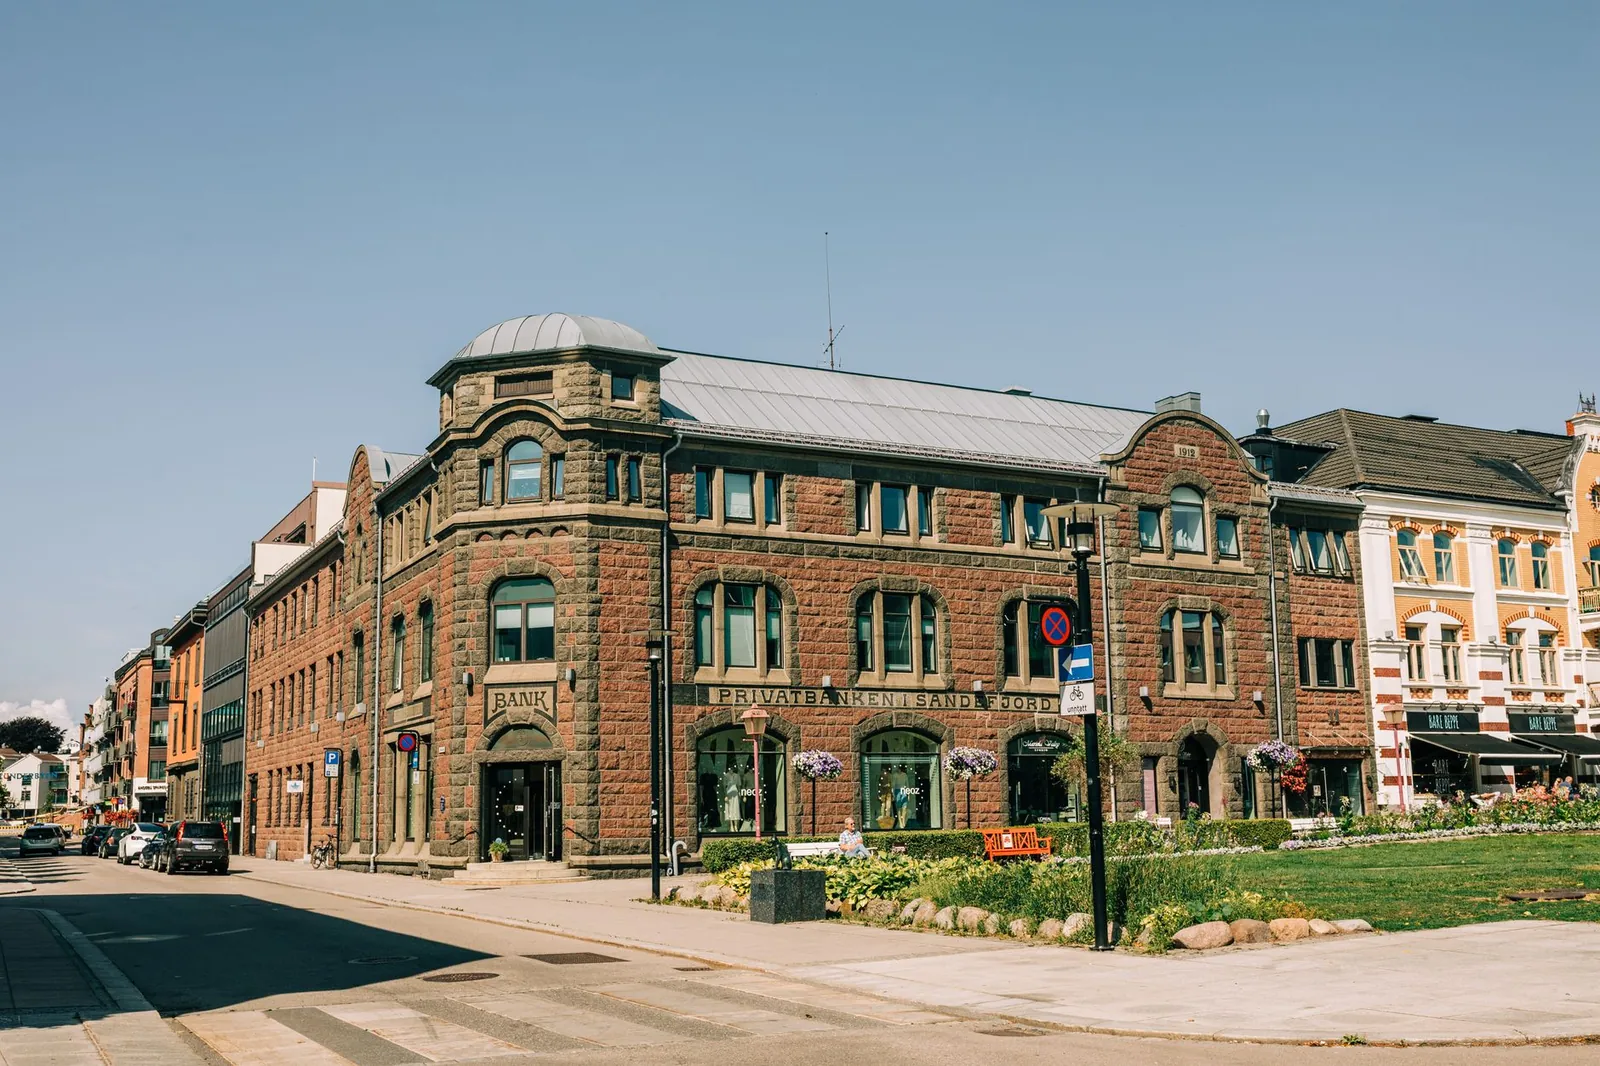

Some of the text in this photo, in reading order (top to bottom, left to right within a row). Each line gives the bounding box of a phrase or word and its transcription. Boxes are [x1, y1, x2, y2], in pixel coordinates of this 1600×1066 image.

[1178, 447, 1196, 457] 1912
[491, 691, 549, 713] BANK
[718, 688, 894, 707] PRIVATBANKEN
[916, 693, 1051, 710] SANDEFJORD
[1428, 714, 1460, 730] BARE BEPPE
[1528, 716, 1558, 730] BARE BEPPE
[328, 753, 336, 764] P
[900, 787, 920, 795] neoz
